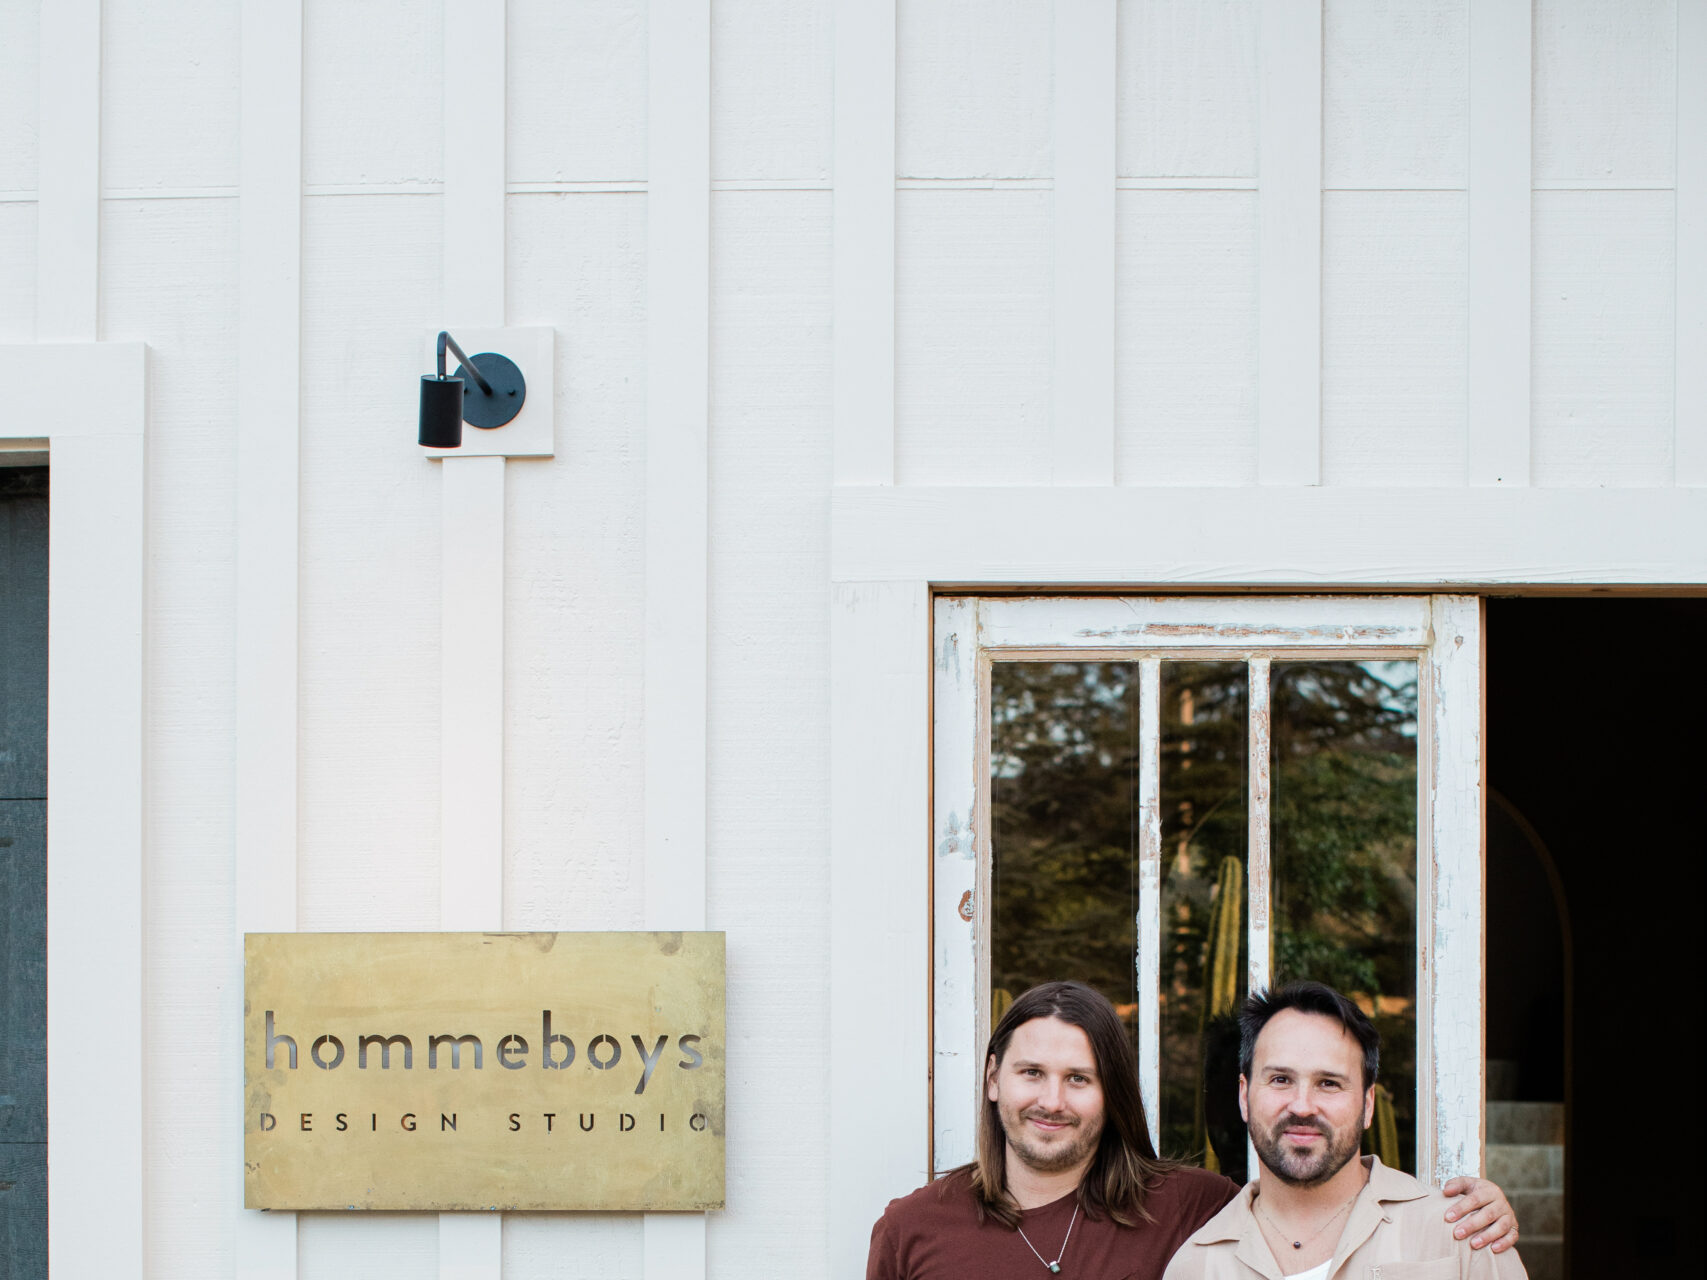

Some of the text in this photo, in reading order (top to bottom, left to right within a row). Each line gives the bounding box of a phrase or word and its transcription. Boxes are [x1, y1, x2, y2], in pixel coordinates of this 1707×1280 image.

[265, 1010, 703, 1094] hommeboys
[260, 1113, 707, 1132] DESIGN STUDIO
